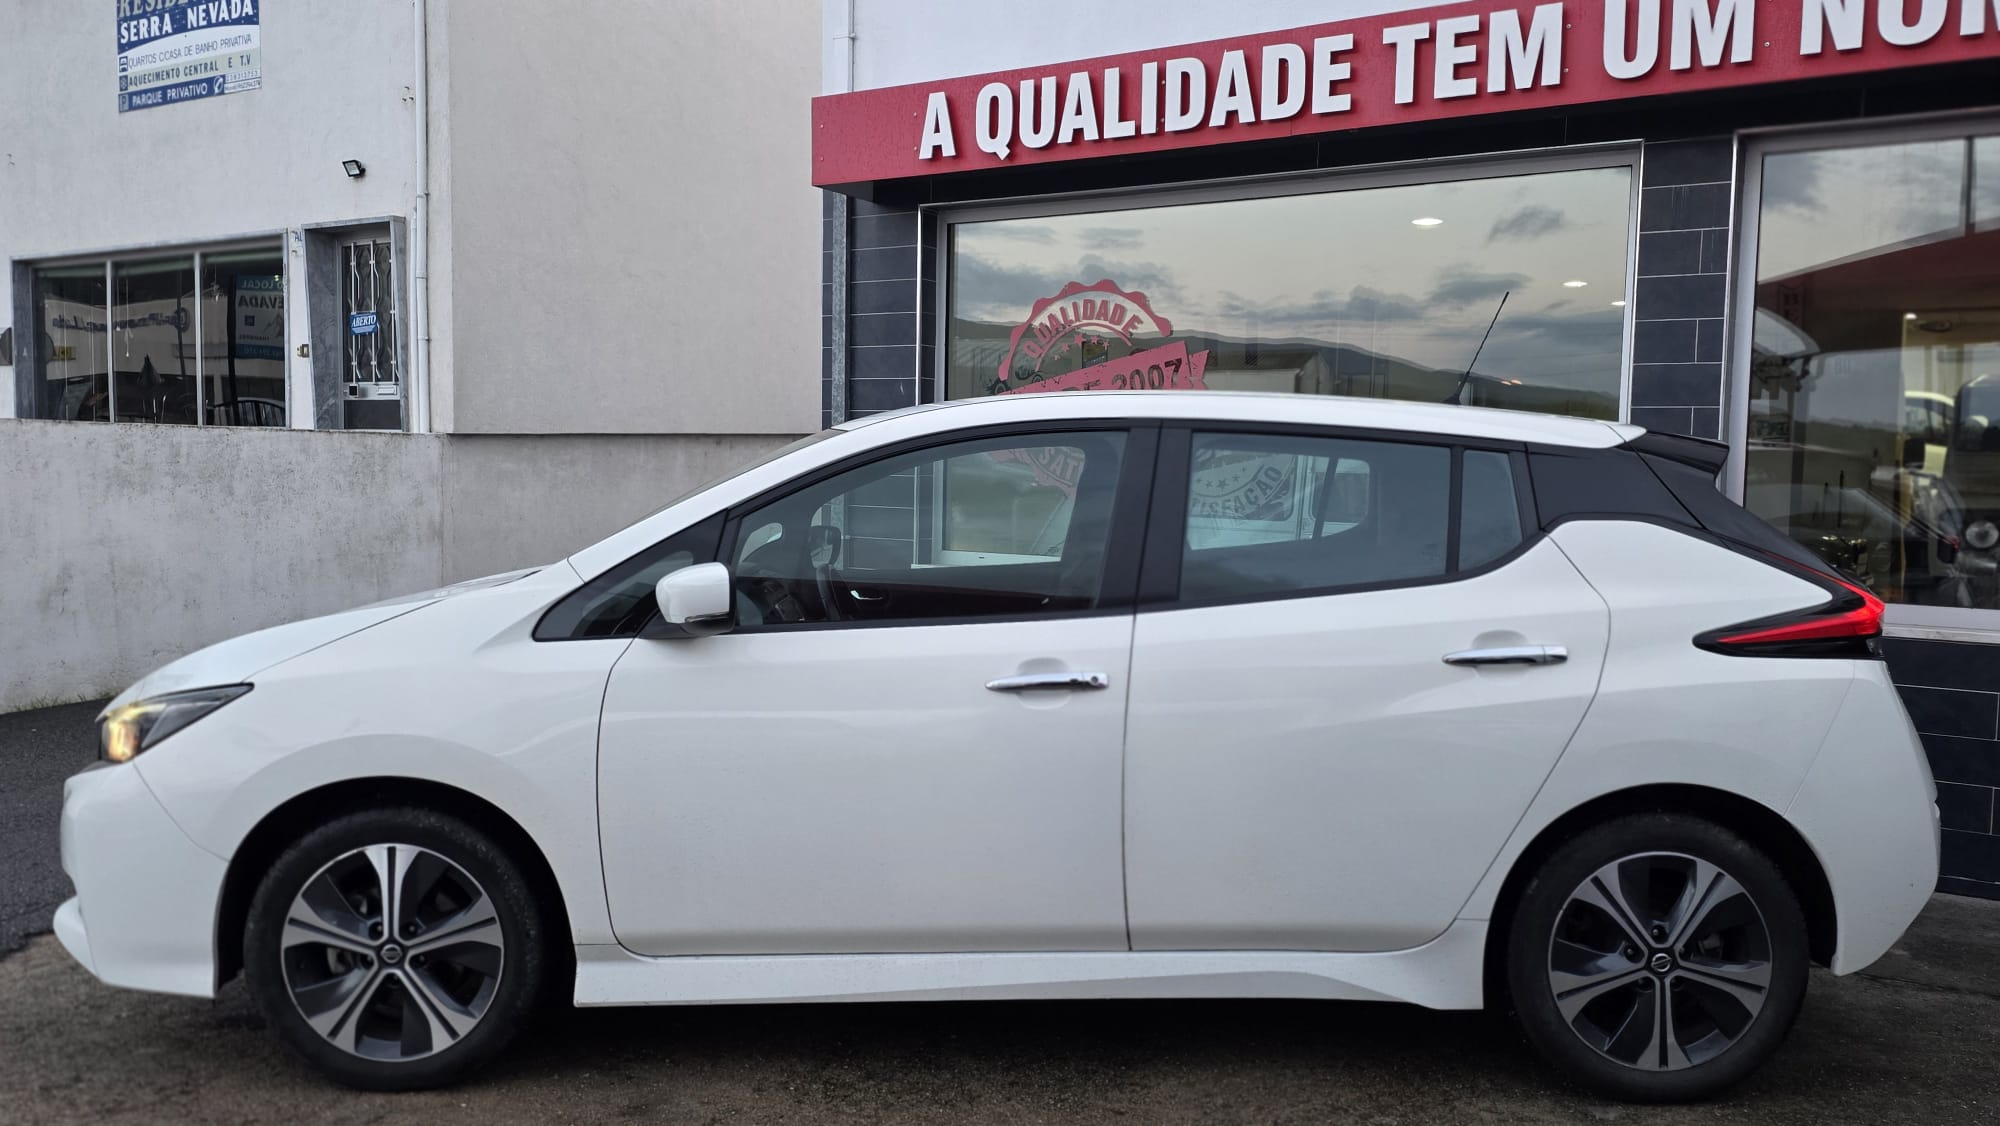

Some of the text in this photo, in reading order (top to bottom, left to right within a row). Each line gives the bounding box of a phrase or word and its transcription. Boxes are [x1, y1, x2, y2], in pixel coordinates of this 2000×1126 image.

[120, 0, 254, 44] SERRA NEVADA
[128, 54, 157, 70] QUARTOS
[184, 45, 193, 57] DE
[195, 40, 218, 55] BANHO
[220, 34, 252, 49] PRIVATIVA
[128, 68, 181, 87] AQUECIMENTO
[184, 60, 219, 76] CENTRAL
[228, 57, 232, 68] E
[918, 91, 957, 160] A
[975, 33, 1354, 160] QUALIDADE
[1382, 2, 1563, 104] TEM
[1602, 0, 1755, 80] UM
[132, 91, 162, 107] PARQUE
[167, 83, 208, 100] PRIVATIVO
[351, 314, 376, 328] ABERTO
[1023, 299, 1144, 359] QUALIDADE
[1111, 357, 1182, 389] 2007
